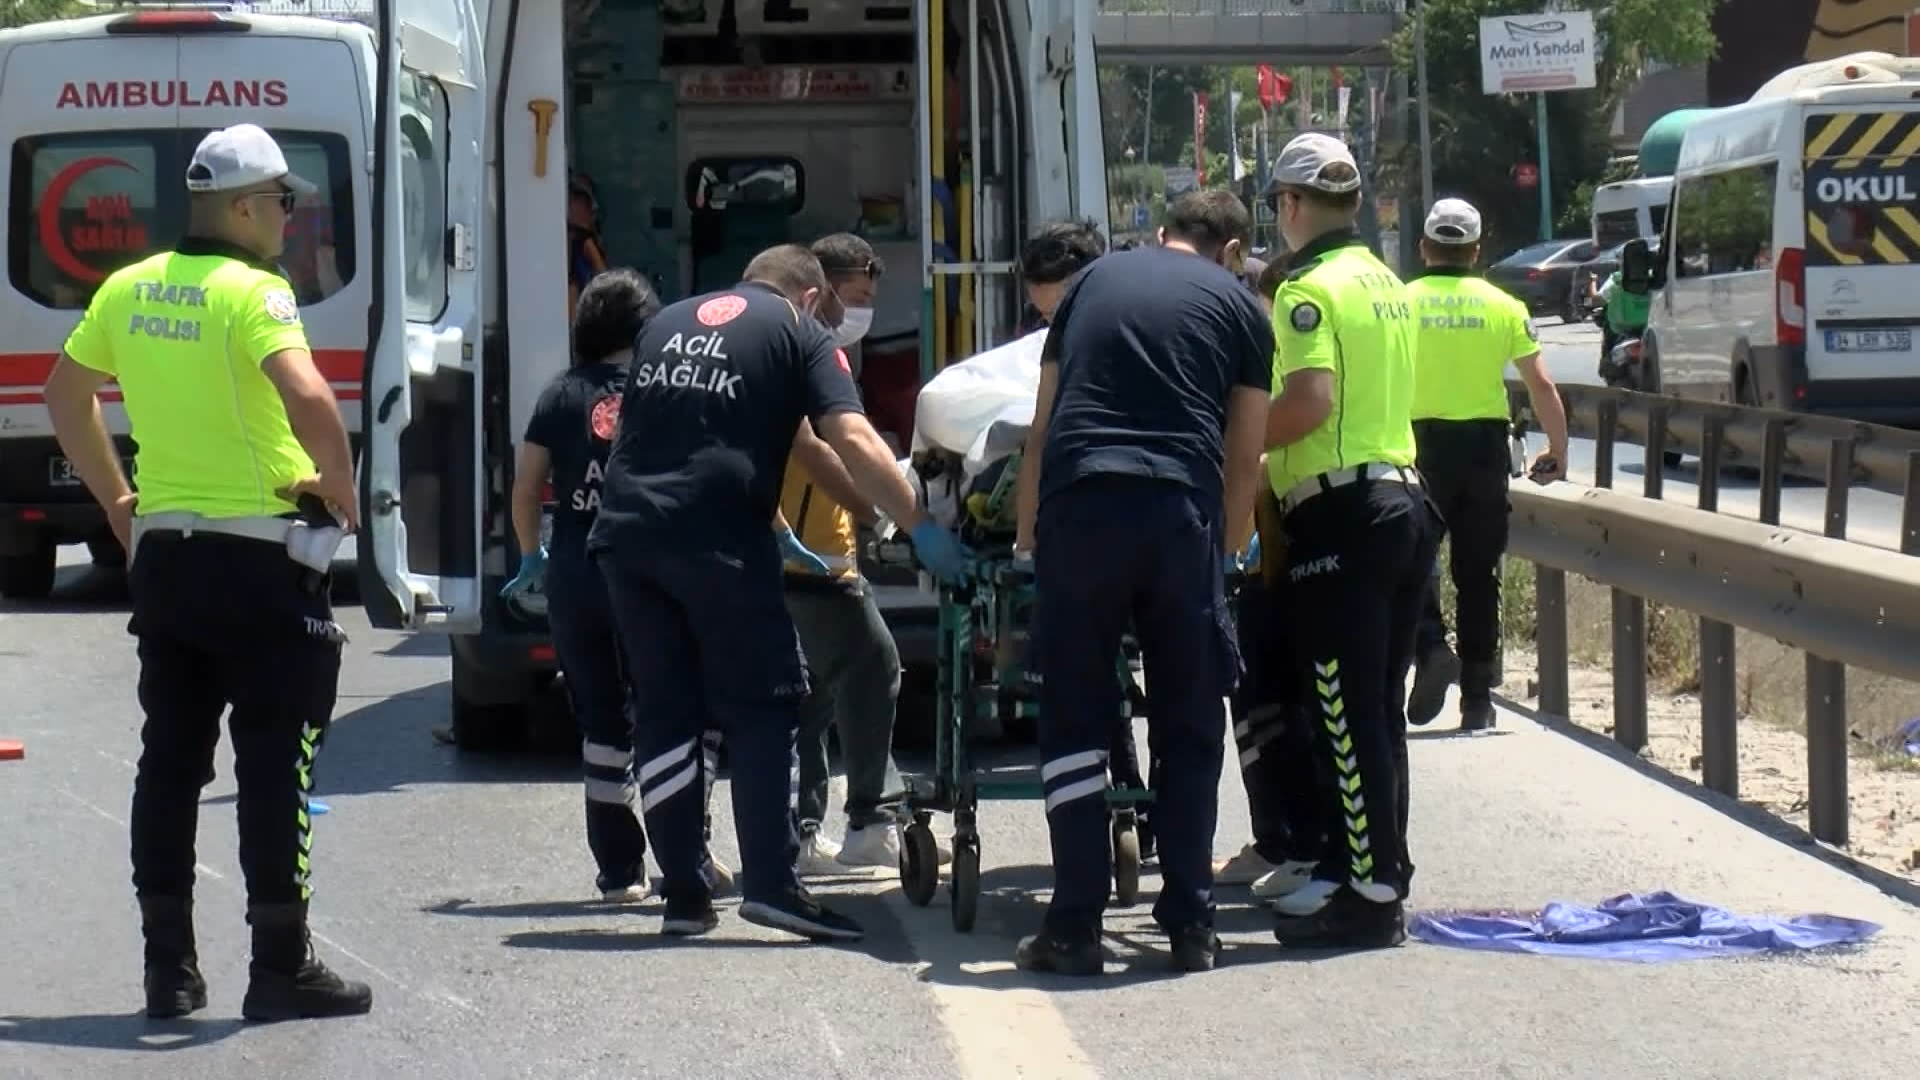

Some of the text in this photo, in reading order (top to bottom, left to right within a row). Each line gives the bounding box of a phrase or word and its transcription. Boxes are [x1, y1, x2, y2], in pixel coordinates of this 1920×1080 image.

[1489, 39, 1585, 60] Mavi Sandal
[56, 80, 289, 109] AMBULANS
[1816, 175, 1917, 203] OKUL
[662, 331, 728, 359] ACİL
[636, 359, 743, 399] SAĞLIK
